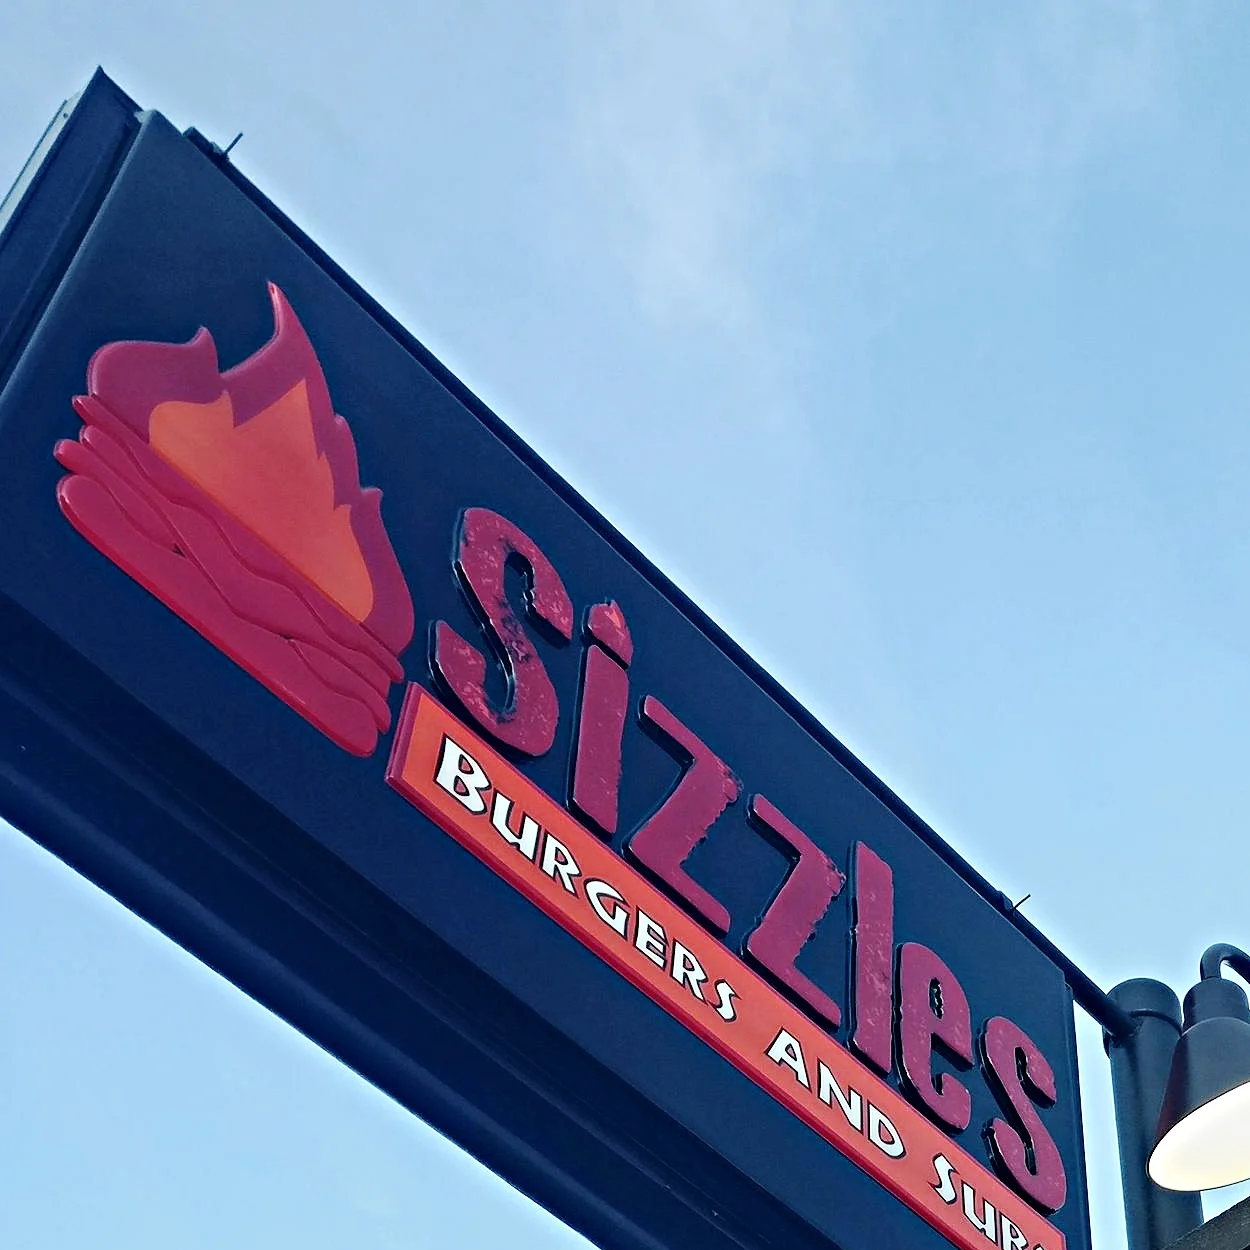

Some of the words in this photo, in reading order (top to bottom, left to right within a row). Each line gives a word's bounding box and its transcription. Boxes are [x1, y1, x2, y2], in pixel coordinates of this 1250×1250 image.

[430, 507, 1067, 1213] Sizzles
[434, 733, 738, 1022] BURGERS
[767, 1028, 906, 1159] AND
